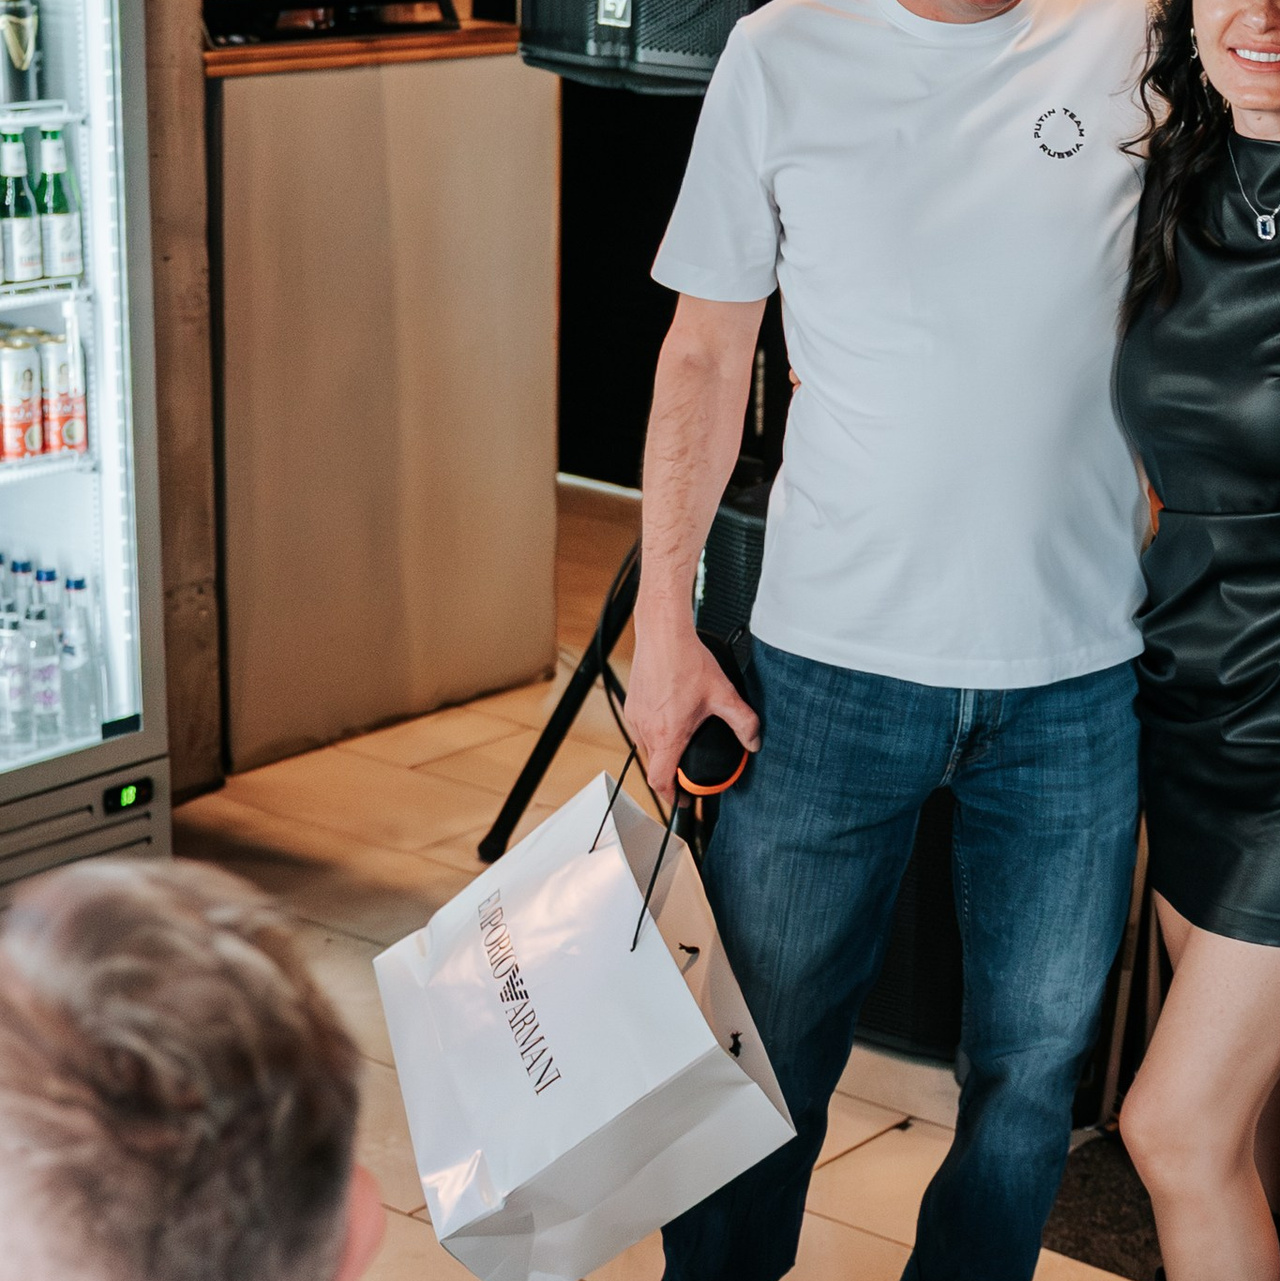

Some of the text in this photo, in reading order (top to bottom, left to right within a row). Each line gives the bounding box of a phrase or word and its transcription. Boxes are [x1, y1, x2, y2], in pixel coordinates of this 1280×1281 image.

[1034, 107, 1085, 139] PUTIN TEAM
[1039, 143, 1084, 159] RUSSIA
[505, 999, 562, 1096] ARMANI
